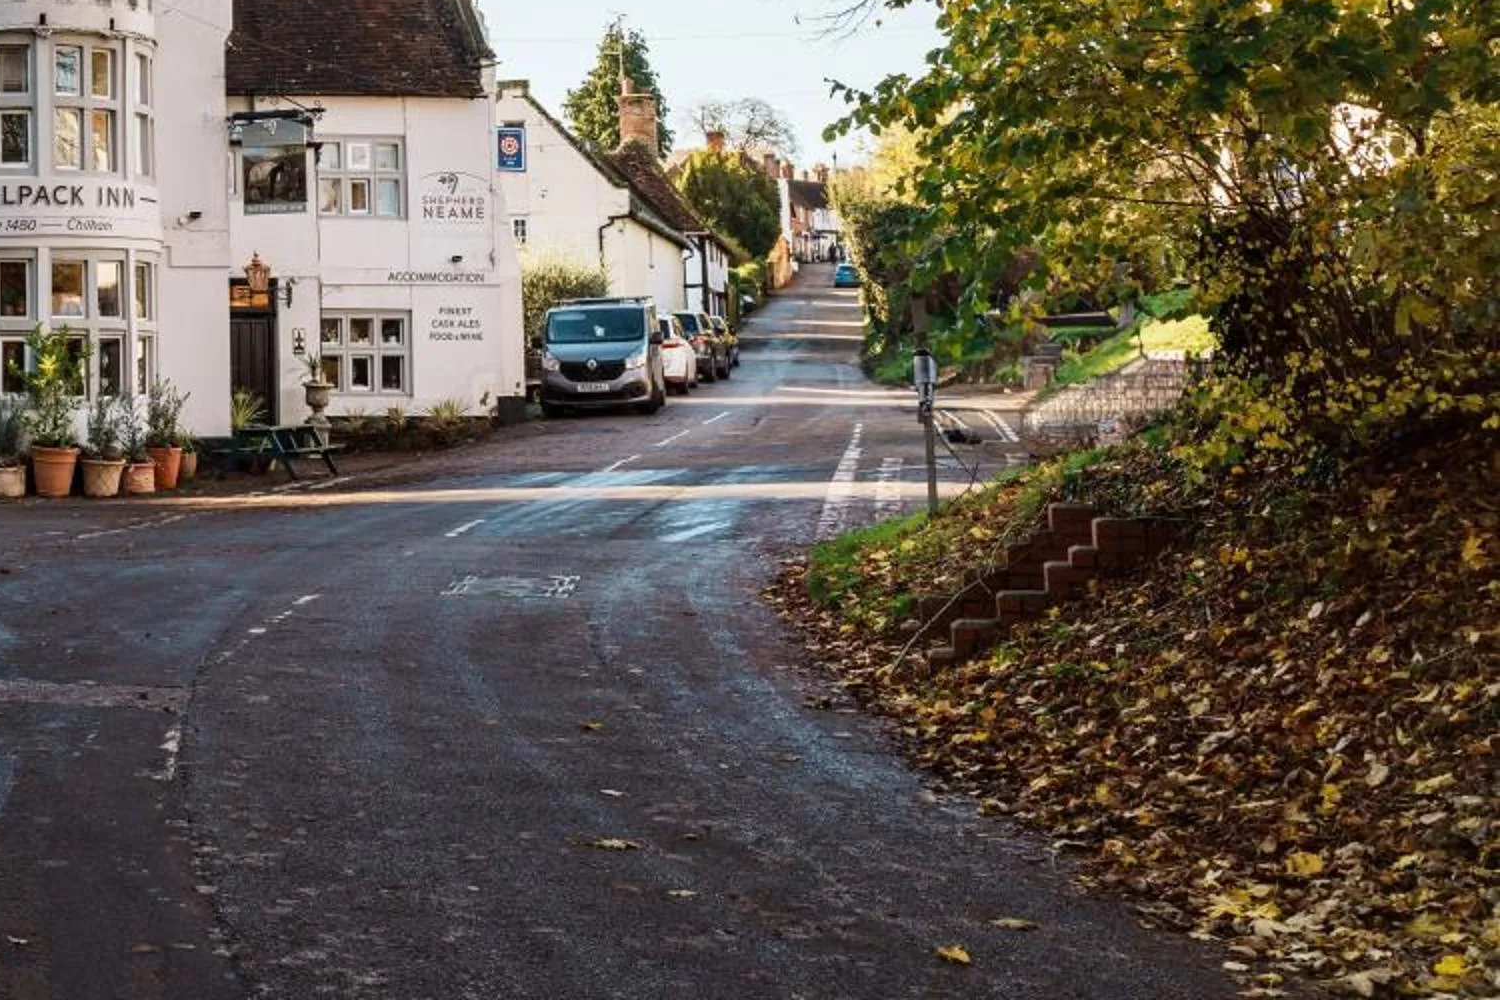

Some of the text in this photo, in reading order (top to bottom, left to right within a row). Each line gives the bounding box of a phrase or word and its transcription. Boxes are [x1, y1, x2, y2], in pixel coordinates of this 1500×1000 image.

[98, 187, 136, 208] INN
[421, 195, 485, 205] SHEPHERD
[423, 205, 485, 219] NEAME
[387, 271, 485, 283] ACCOMMODATION
[457, 319, 481, 329] ALES
